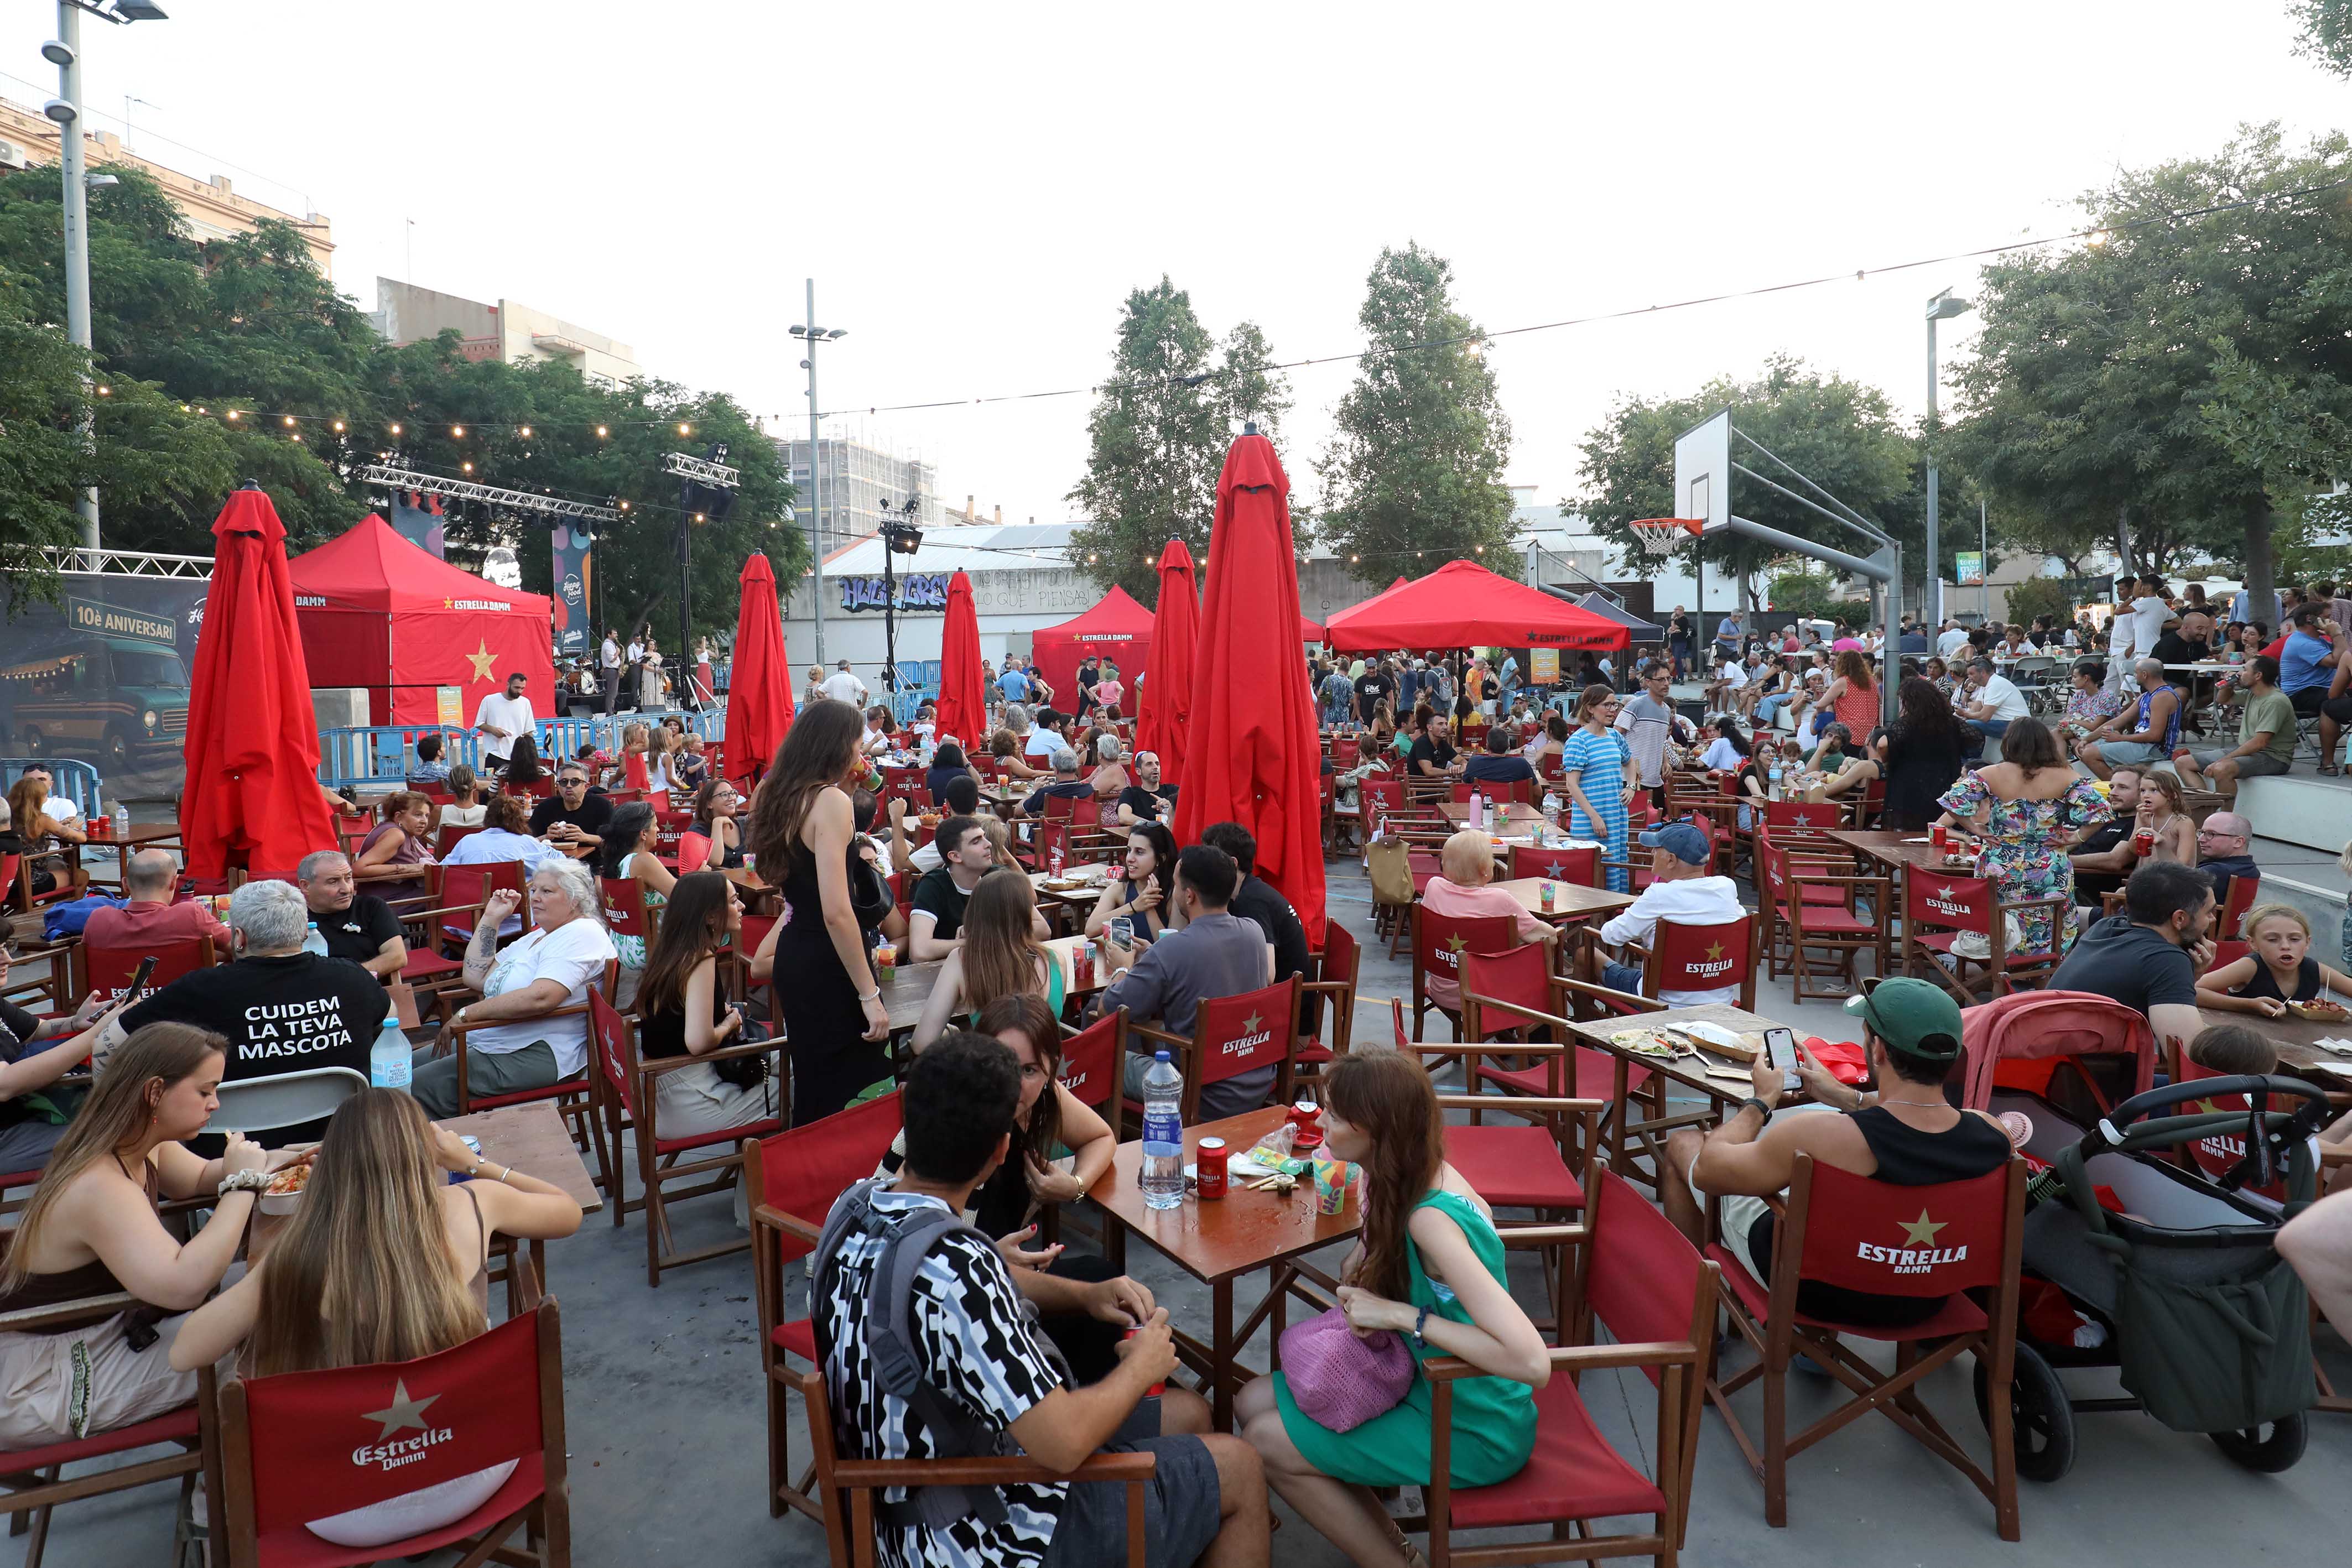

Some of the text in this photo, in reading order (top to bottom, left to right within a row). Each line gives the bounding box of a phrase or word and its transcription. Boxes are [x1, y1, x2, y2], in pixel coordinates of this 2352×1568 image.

[563, 580, 580, 592] Happy
[568, 587, 582, 598] Food
[295, 596, 326, 607] DAMM
[454, 600, 511, 611] ESTRELLA DAMM
[976, 592, 992, 606] LO
[997, 592, 1027, 608] QUE
[77, 606, 102, 627] 10è
[105, 613, 172, 639] ANIVERSARI
[1539, 634, 1583, 644] ESTRELLA
[1926, 898, 1971, 914] ESTRELLA
[1435, 947, 1458, 963] ESTR
[1685, 958, 1733, 973] ESTRELLA
[244, 996, 340, 1021] CUIDEM
[248, 1013, 343, 1040] LA TEVA
[238, 1029, 352, 1060] MASCOTA
[1222, 1030, 1271, 1054] ESTRELLA
[1237, 1046, 1254, 1057] DAMM
[2200, 1142, 2225, 1159] DAMM
[1857, 1241, 1968, 1265] ESTRELLA
[1893, 1265, 1932, 1274] DAMM
[351, 1428, 454, 1466] Estrella
[381, 1451, 426, 1471] Damm
